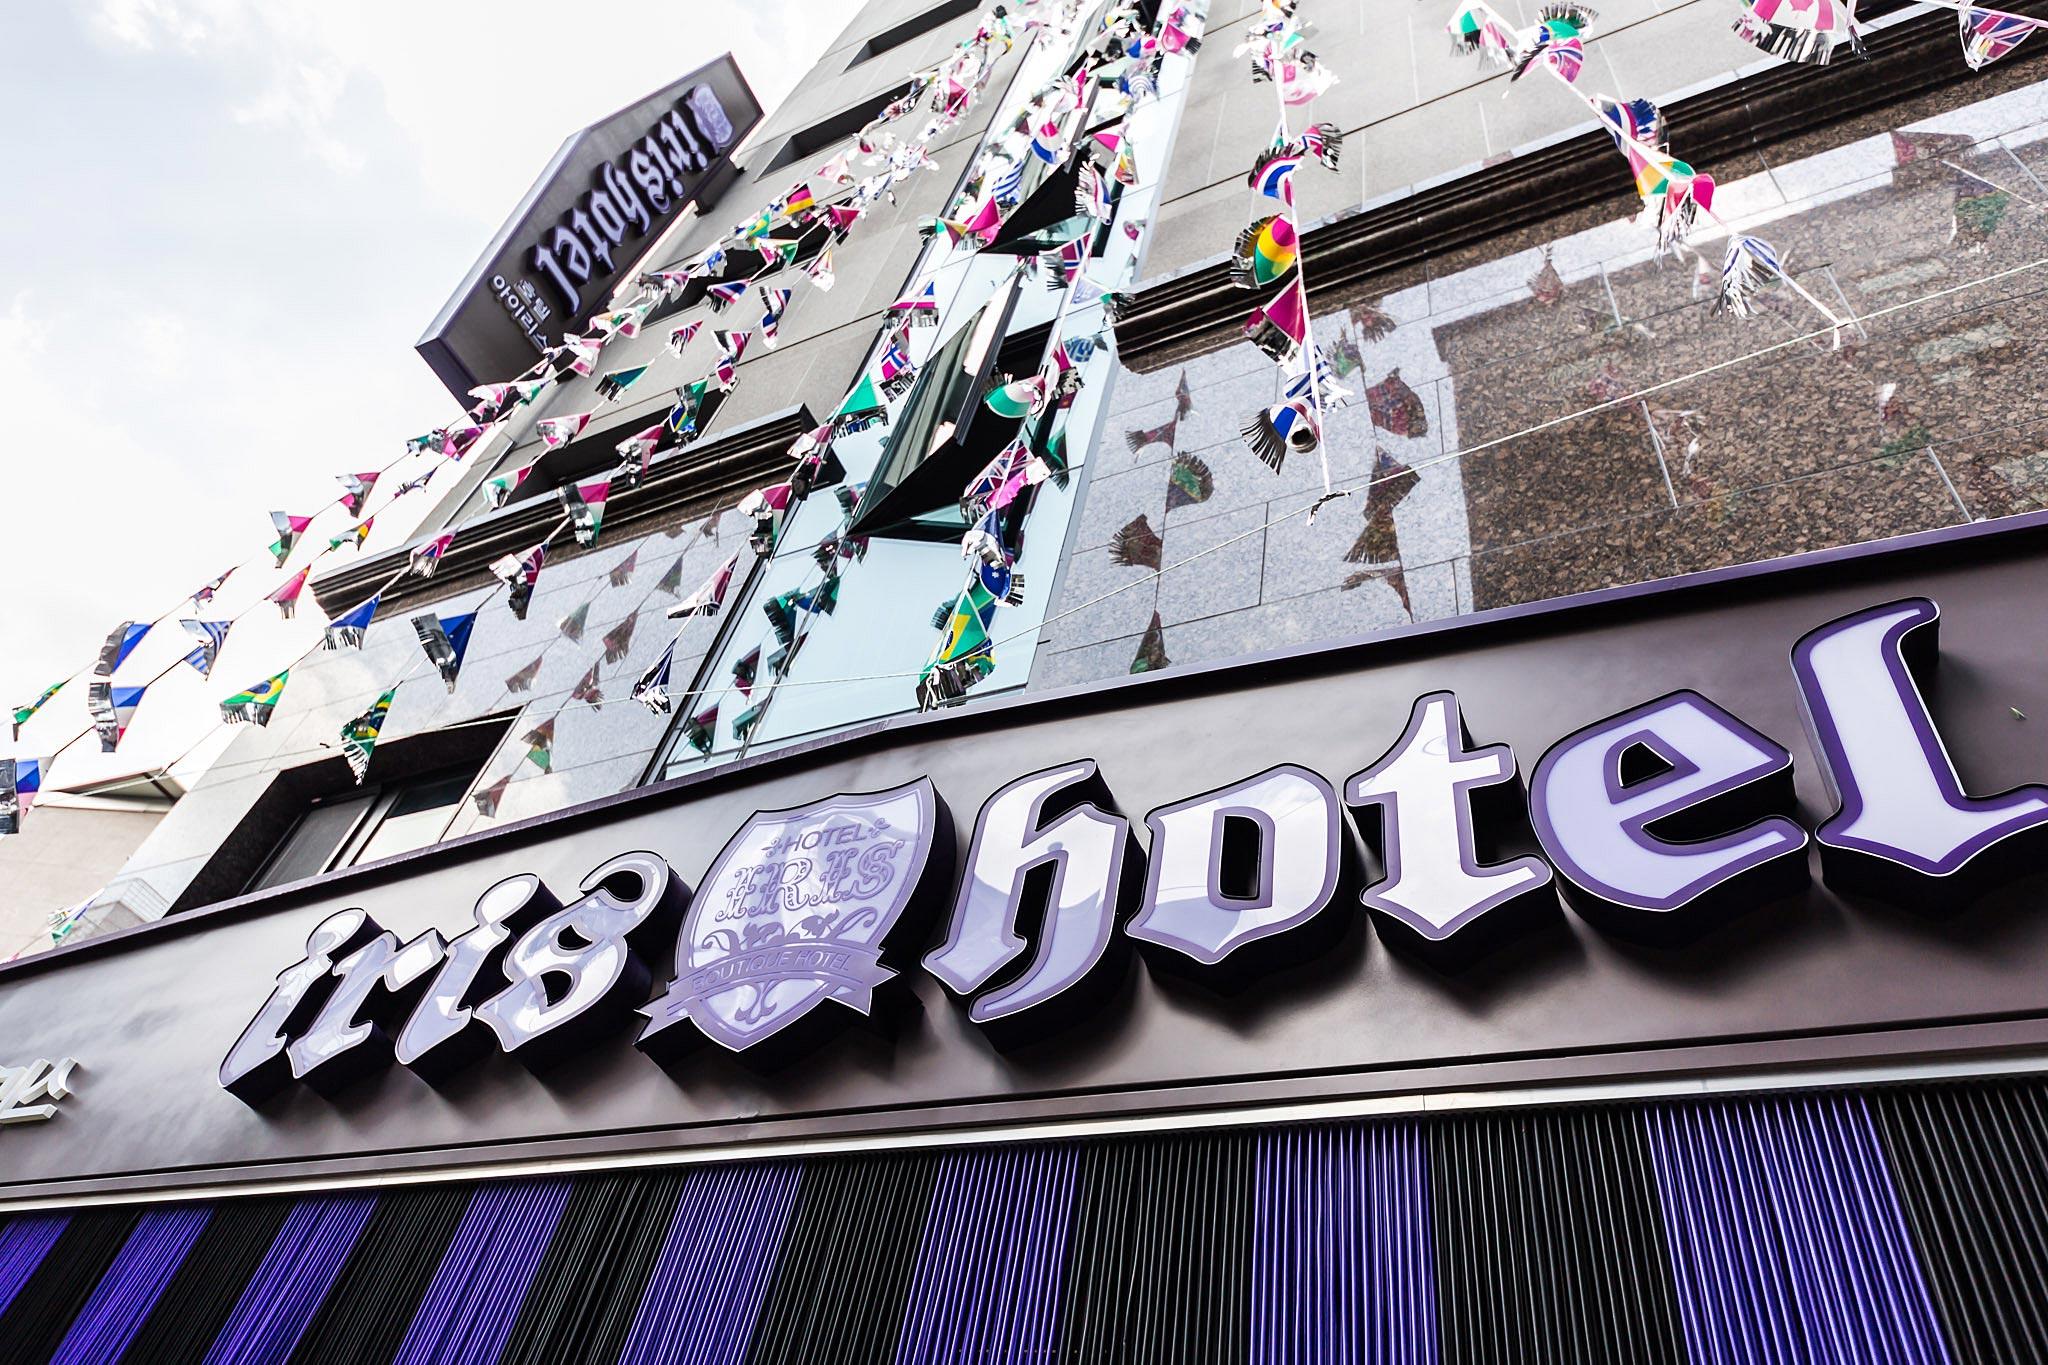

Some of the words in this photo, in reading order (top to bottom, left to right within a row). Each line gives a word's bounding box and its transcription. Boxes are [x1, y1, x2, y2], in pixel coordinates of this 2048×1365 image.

[534, 159, 651, 317] hotel
[218, 850, 669, 1087] iris
[921, 597, 2048, 1023] hotel
[782, 823, 868, 854] HOTEL
[714, 840, 905, 923] IRIS
[692, 951, 791, 992] BOUTIQUE
[792, 949, 854, 974] HOTEL
